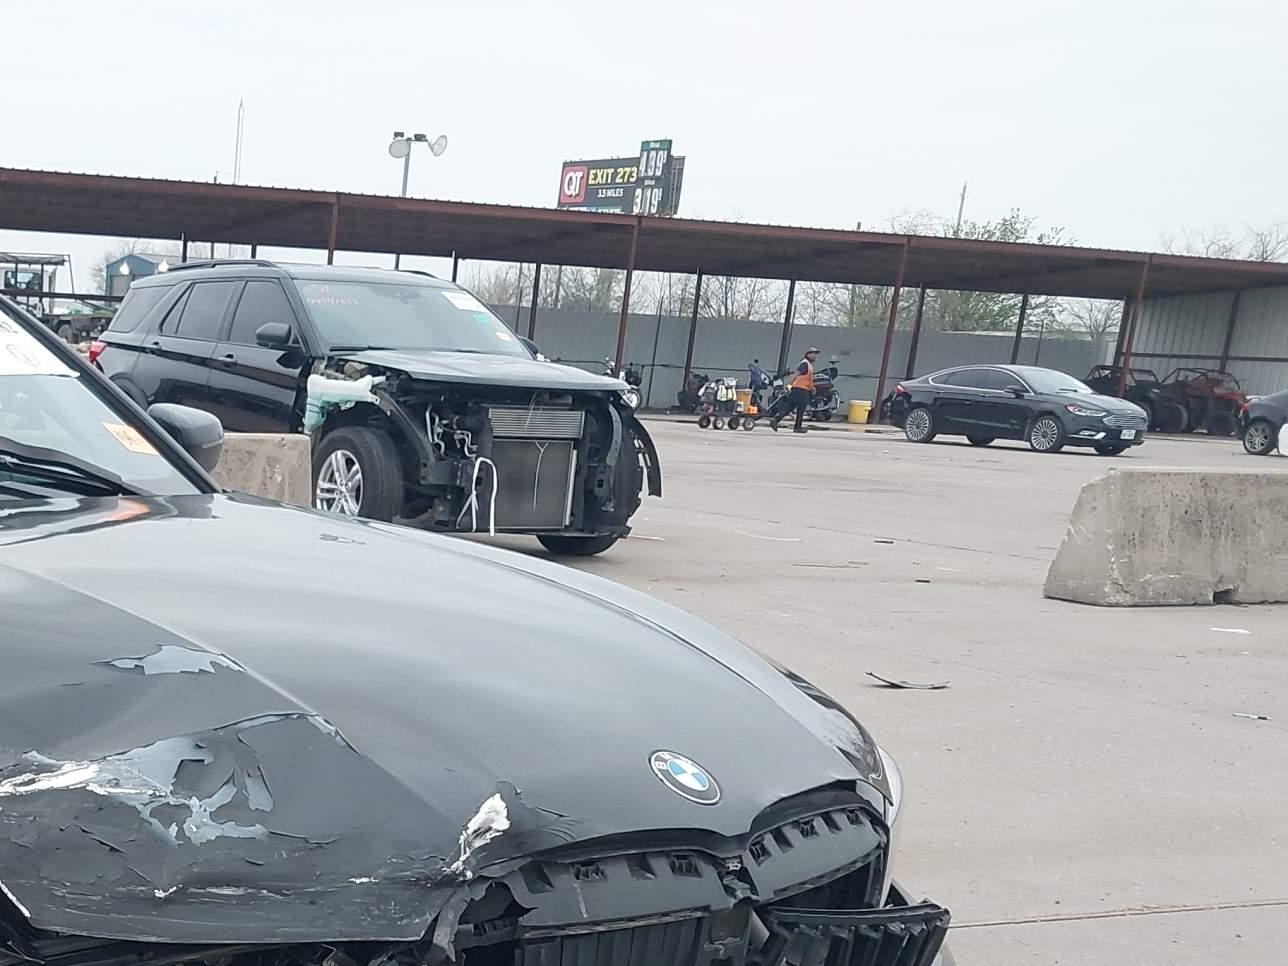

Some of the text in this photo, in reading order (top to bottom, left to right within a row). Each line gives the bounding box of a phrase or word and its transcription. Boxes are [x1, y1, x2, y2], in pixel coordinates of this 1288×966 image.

[564, 171, 583, 198] QT
[589, 166, 638, 185] EXIT 273
